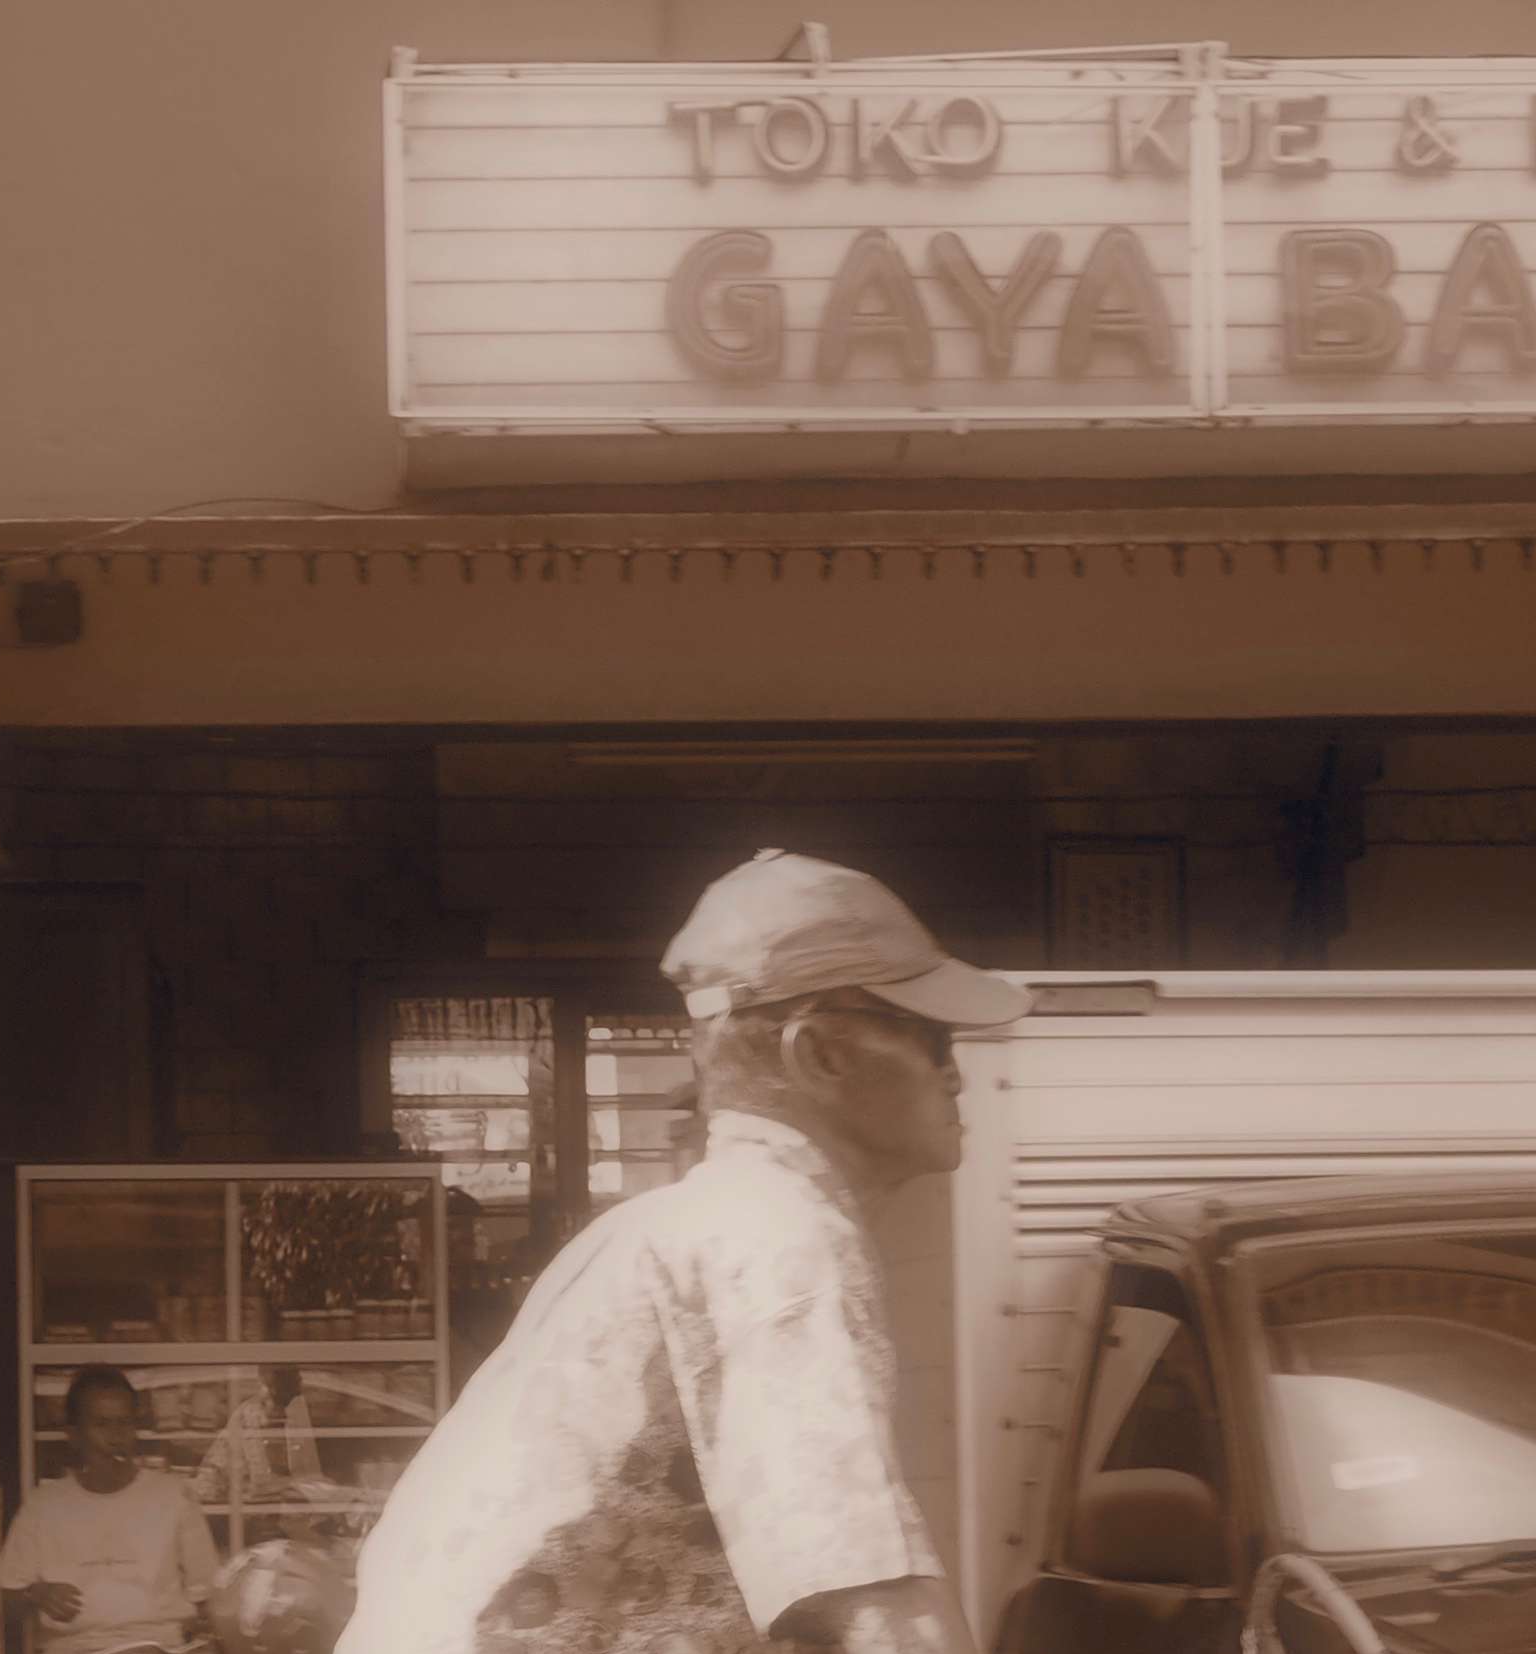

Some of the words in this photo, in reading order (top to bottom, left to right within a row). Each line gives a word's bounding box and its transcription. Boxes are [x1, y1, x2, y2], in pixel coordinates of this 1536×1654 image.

[666, 96, 1002, 185] TOKO
[1394, 95, 1461, 179] &
[663, 226, 1178, 385] GAYA
